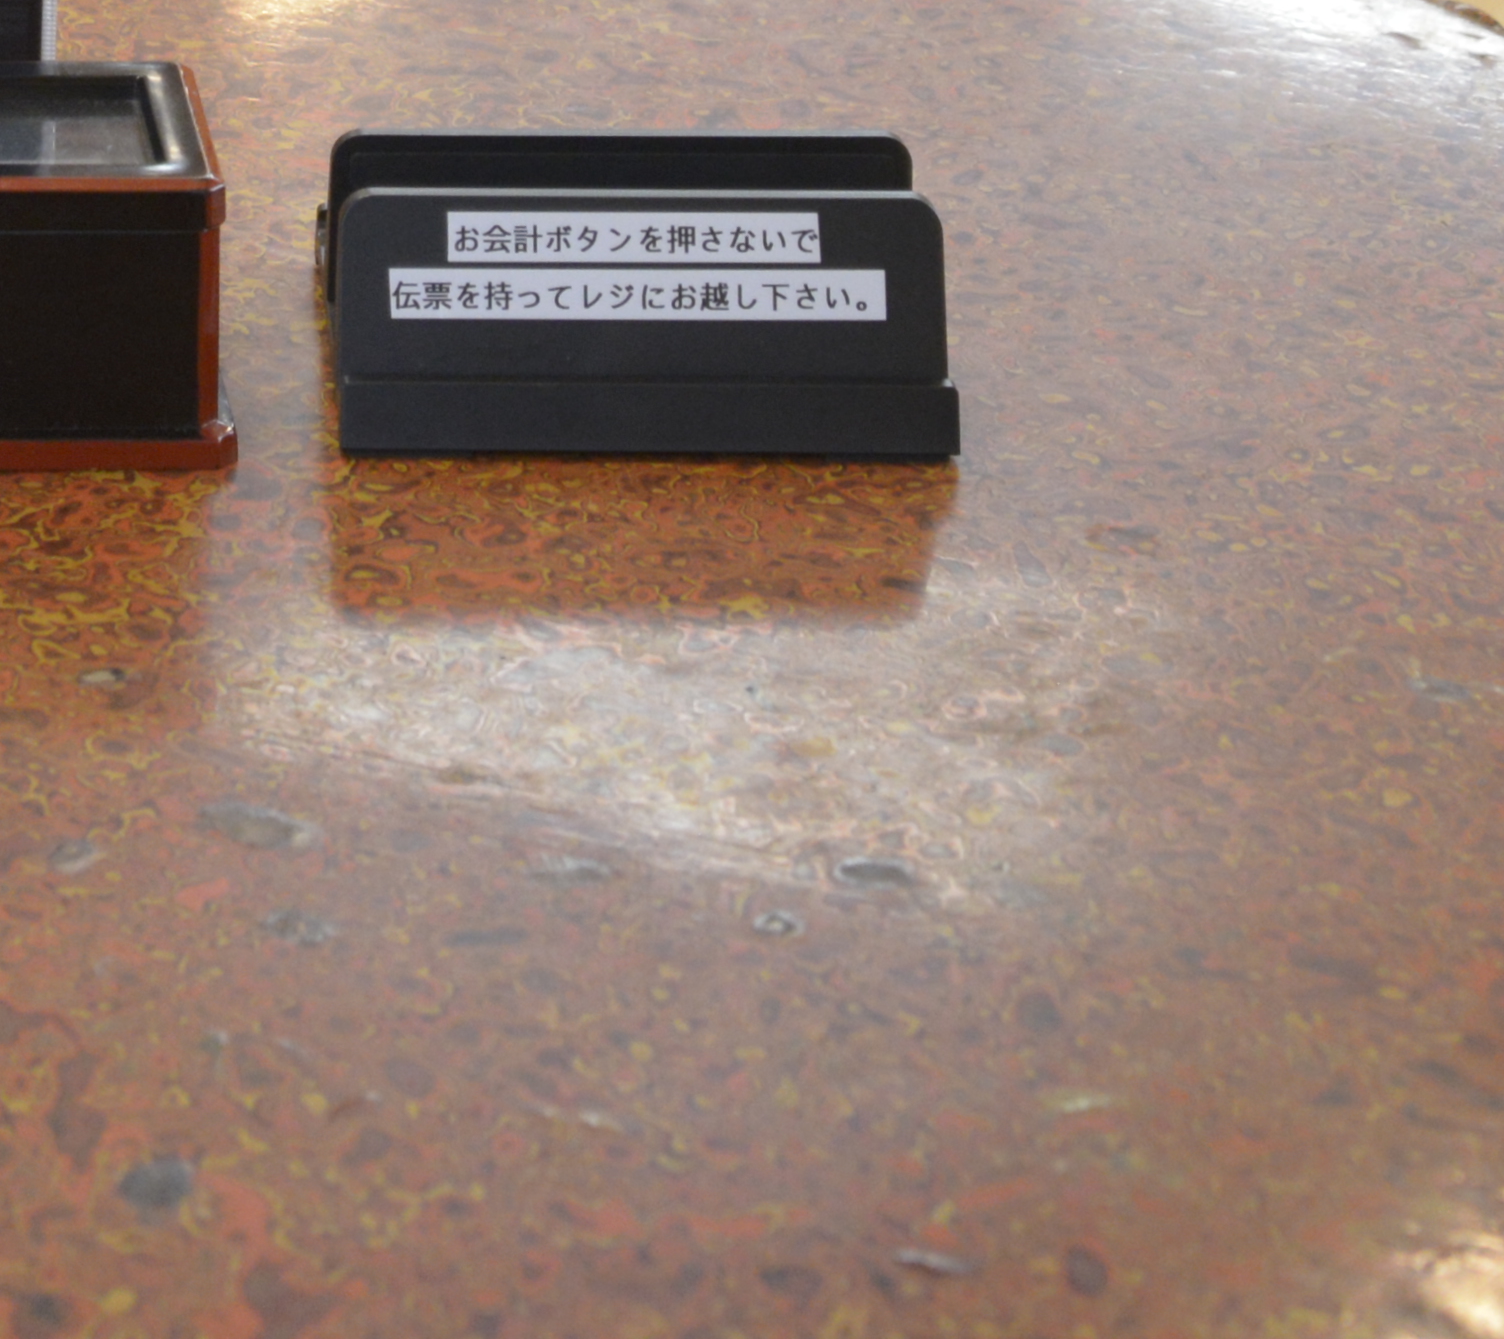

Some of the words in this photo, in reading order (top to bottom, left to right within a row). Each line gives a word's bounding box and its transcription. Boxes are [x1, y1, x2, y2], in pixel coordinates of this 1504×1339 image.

[453, 223, 819, 255] お会計ボタンを押さないで
[391, 280, 868, 312] 伝票を持ってレジにお越し下さい。
